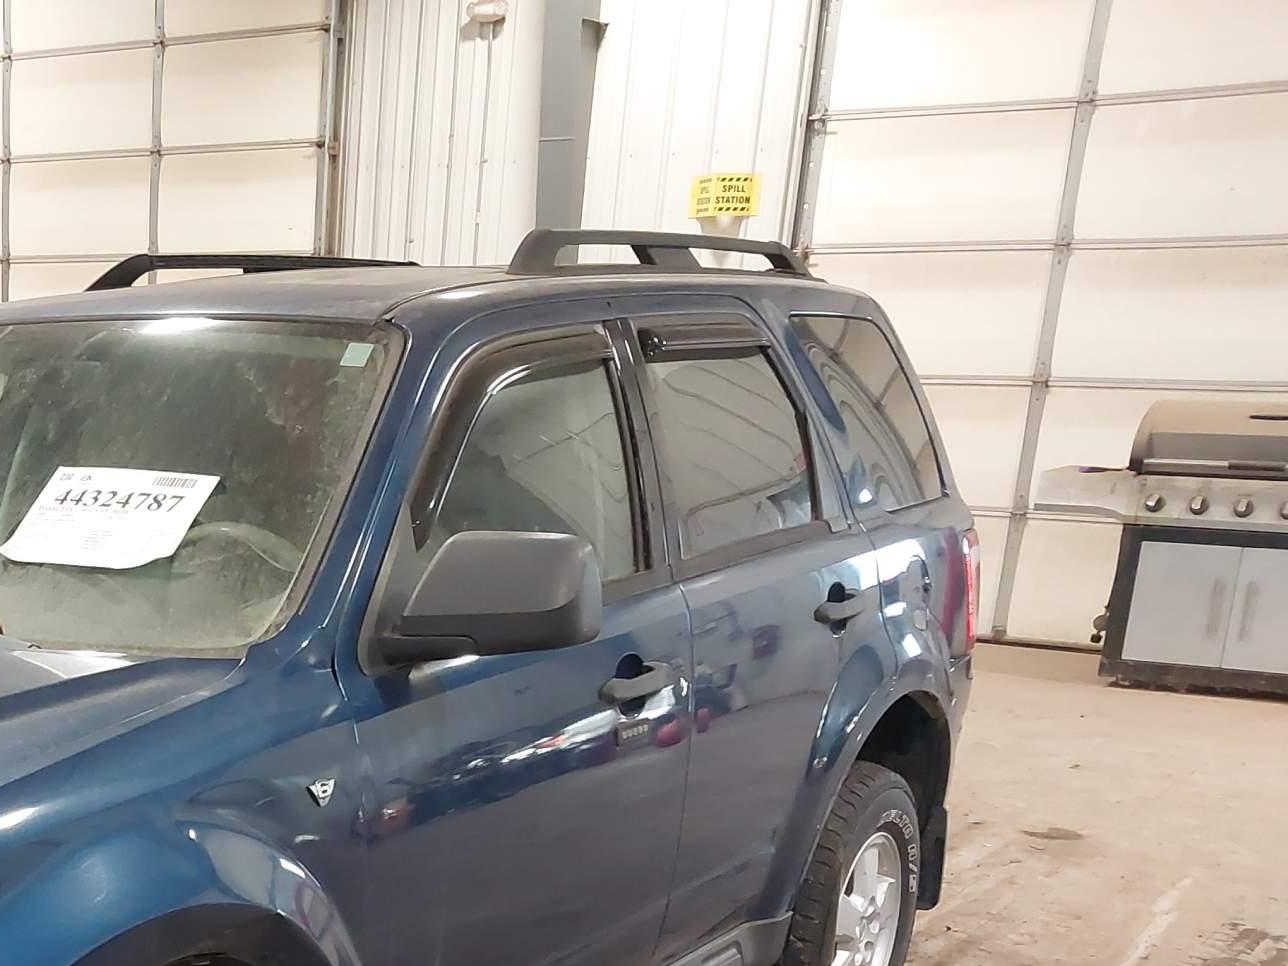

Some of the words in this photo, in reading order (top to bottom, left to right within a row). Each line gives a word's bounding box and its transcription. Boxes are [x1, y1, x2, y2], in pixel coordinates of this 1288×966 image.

[722, 185, 746, 193] SPILL
[715, 196, 751, 204] STATION
[54, 488, 185, 512] 44324787
